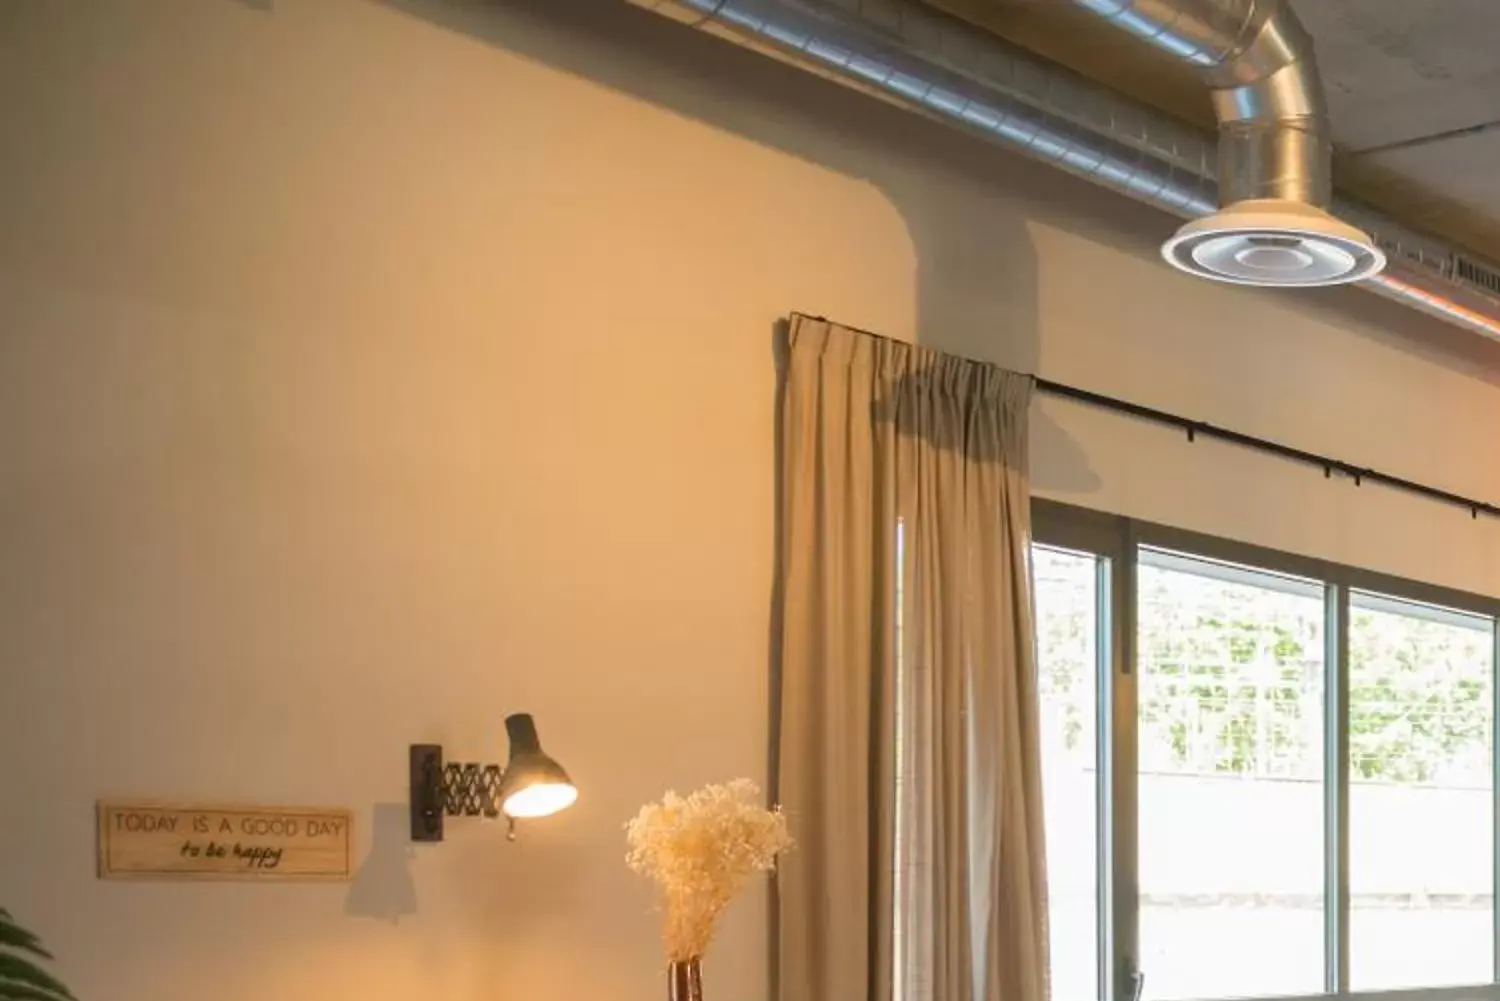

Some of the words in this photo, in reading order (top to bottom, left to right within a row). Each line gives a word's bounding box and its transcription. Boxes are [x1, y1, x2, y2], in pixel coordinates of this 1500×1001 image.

[114, 812, 178, 833] TODAY
[193, 815, 209, 833] IS
[218, 817, 233, 835] A
[240, 818, 298, 837] GOOD
[306, 820, 343, 838] DAY
[180, 840, 200, 858] to
[205, 840, 226, 858] be
[233, 841, 284, 869] happy
